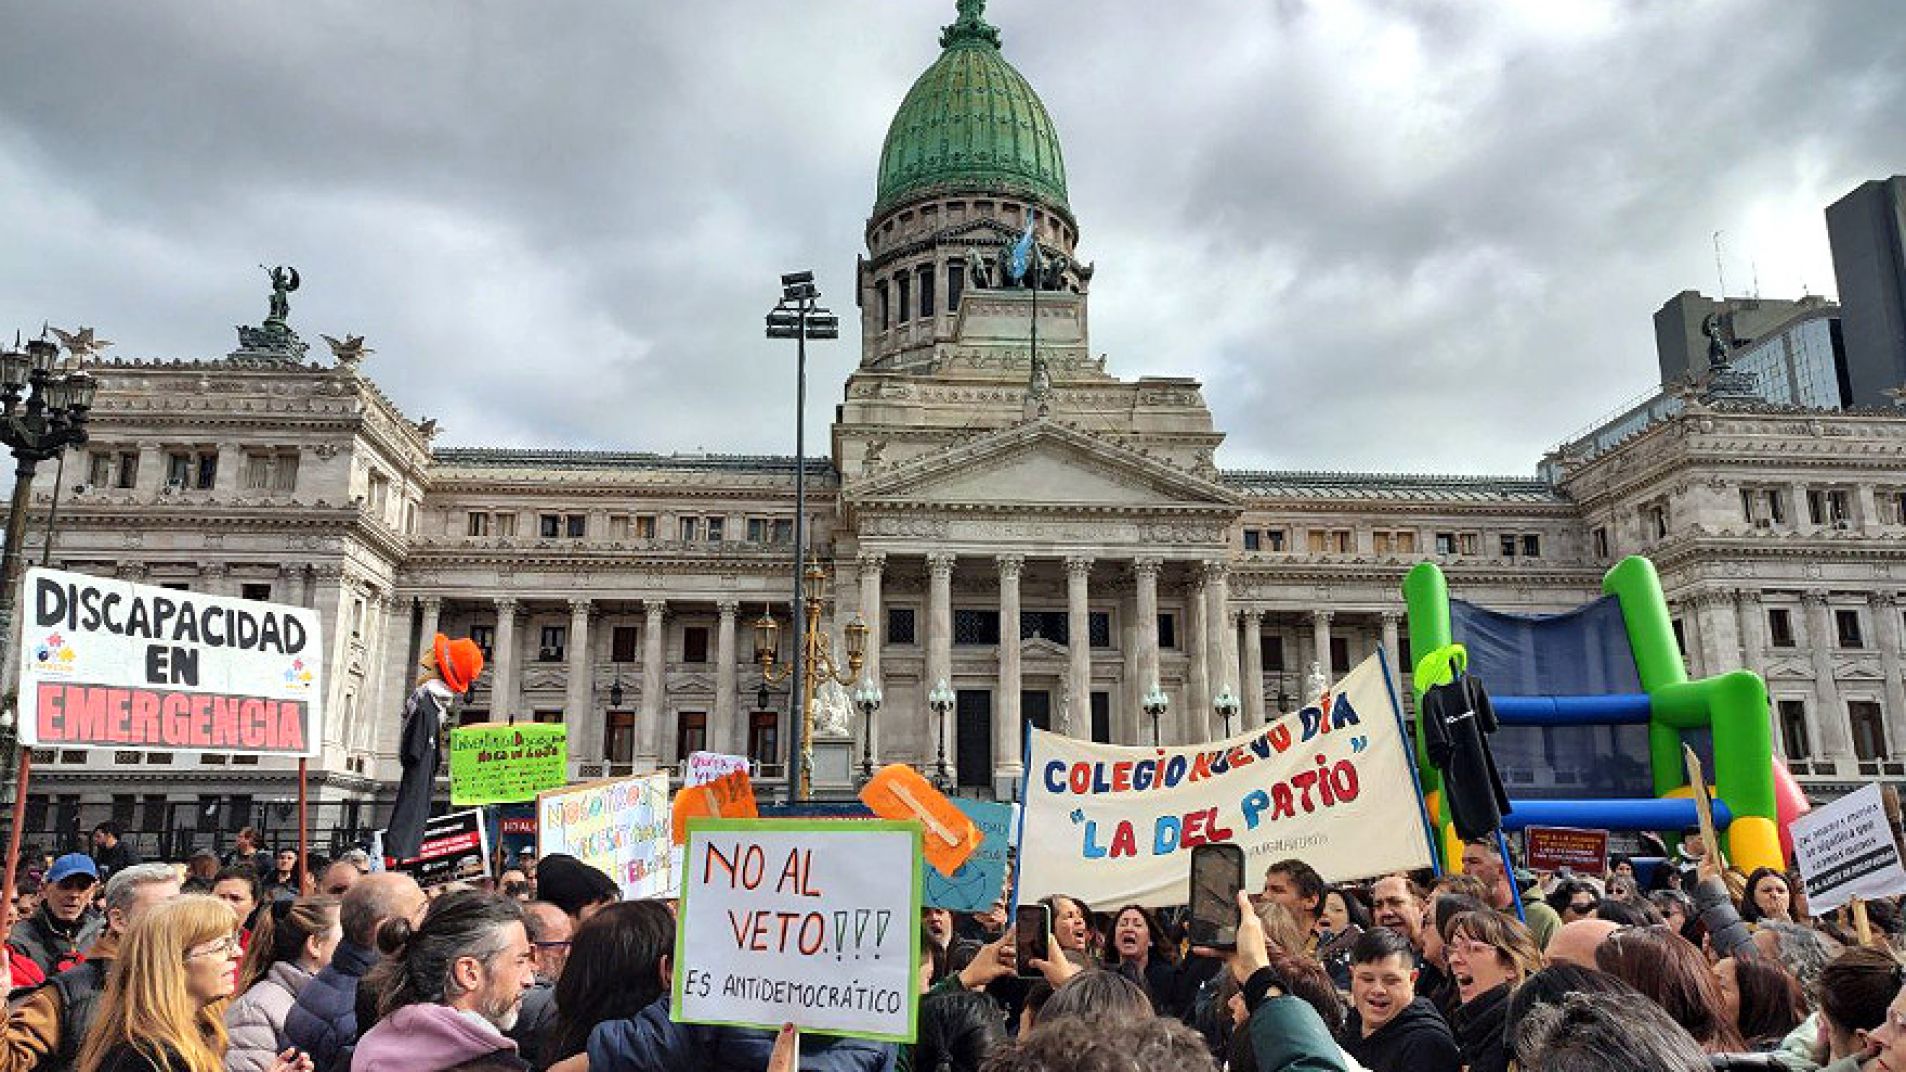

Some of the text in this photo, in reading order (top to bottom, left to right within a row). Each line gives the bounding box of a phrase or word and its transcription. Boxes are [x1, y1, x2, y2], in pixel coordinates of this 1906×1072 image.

[36, 577, 307, 654] DISCAPACIDAD
[147, 644, 199, 686] EN
[37, 685, 305, 751] EMERGENCIA
[1044, 749, 1187, 794] COLEGIO
[1189, 722, 1292, 782] NUEVO
[1153, 806, 1233, 856] DEL
[703, 841, 765, 890] NO
[776, 847, 821, 897] AL
[685, 969, 711, 998] ES
